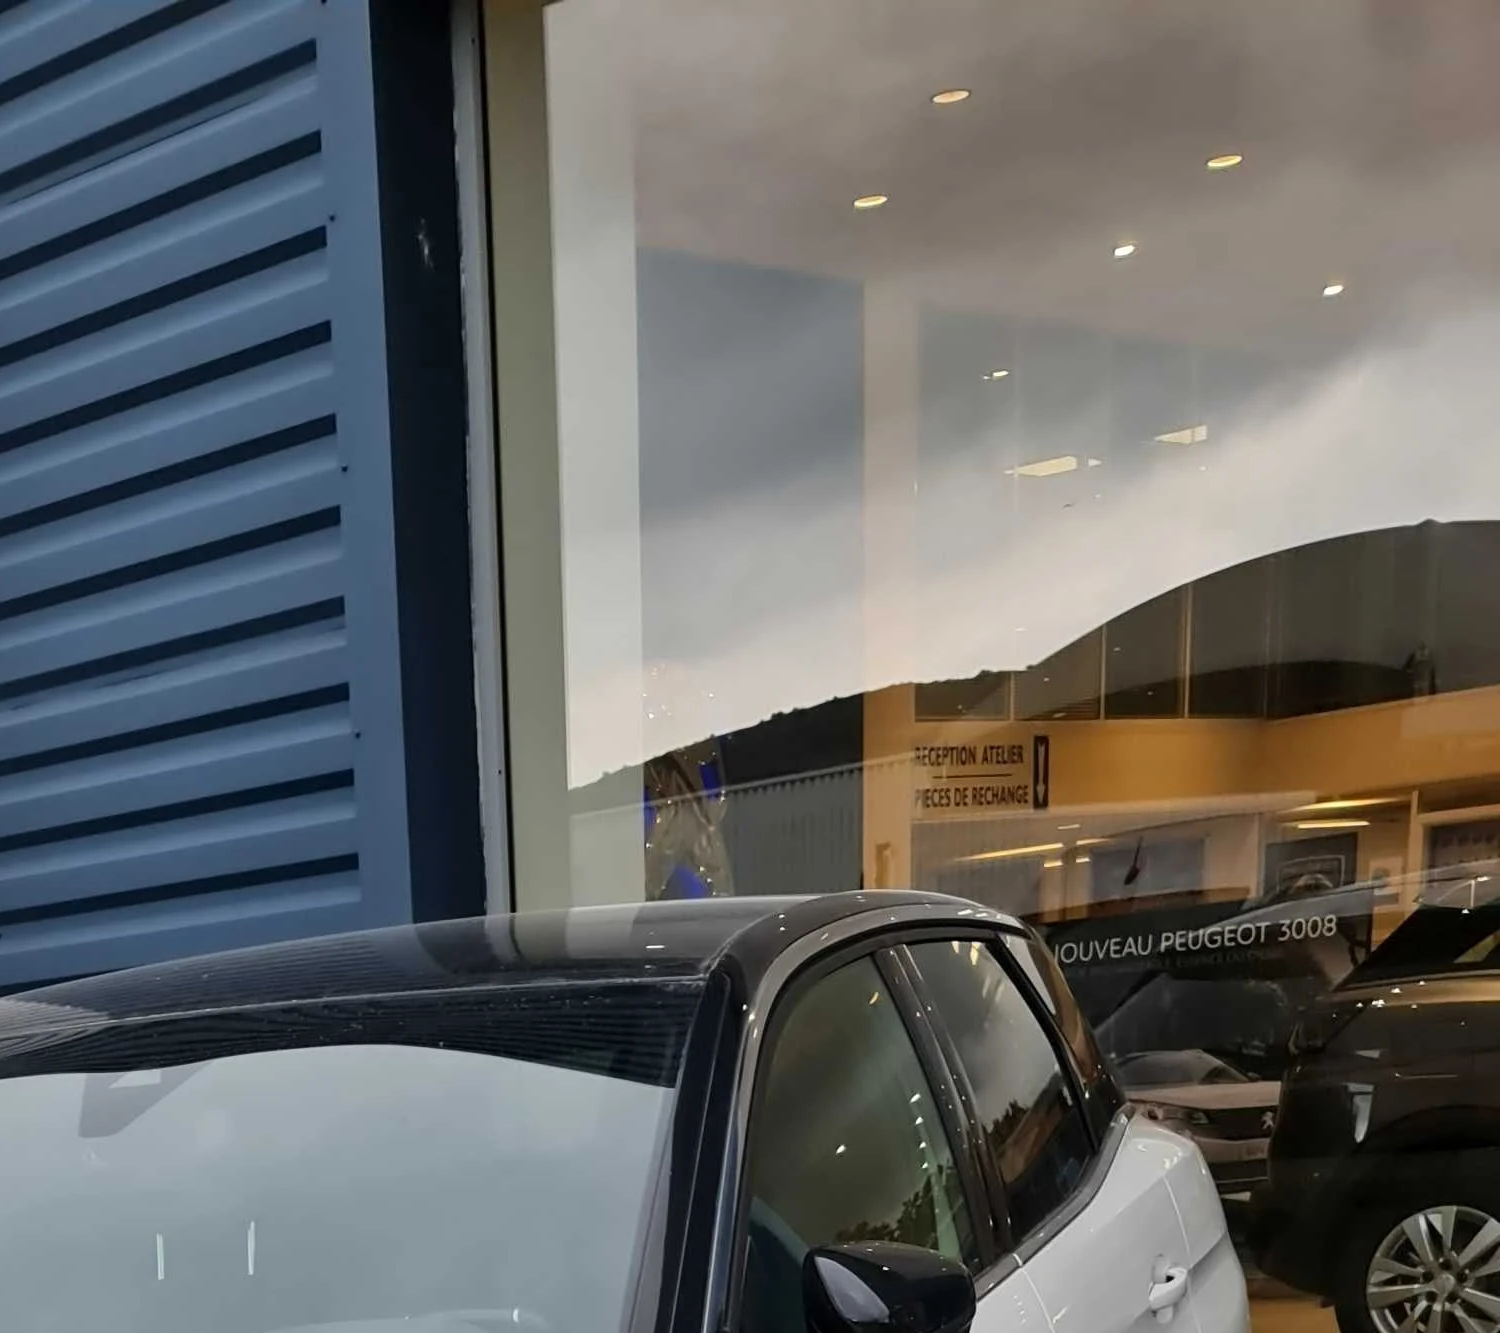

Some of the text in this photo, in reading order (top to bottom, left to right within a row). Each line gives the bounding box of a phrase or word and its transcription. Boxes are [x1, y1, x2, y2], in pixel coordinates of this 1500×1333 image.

[981, 745, 1023, 765] ATELIER
[954, 787, 968, 807] DE
[972, 785, 1028, 806] RECHANGE
[1160, 921, 1271, 953] PEUGEOT
[1277, 914, 1337, 942] 3008
